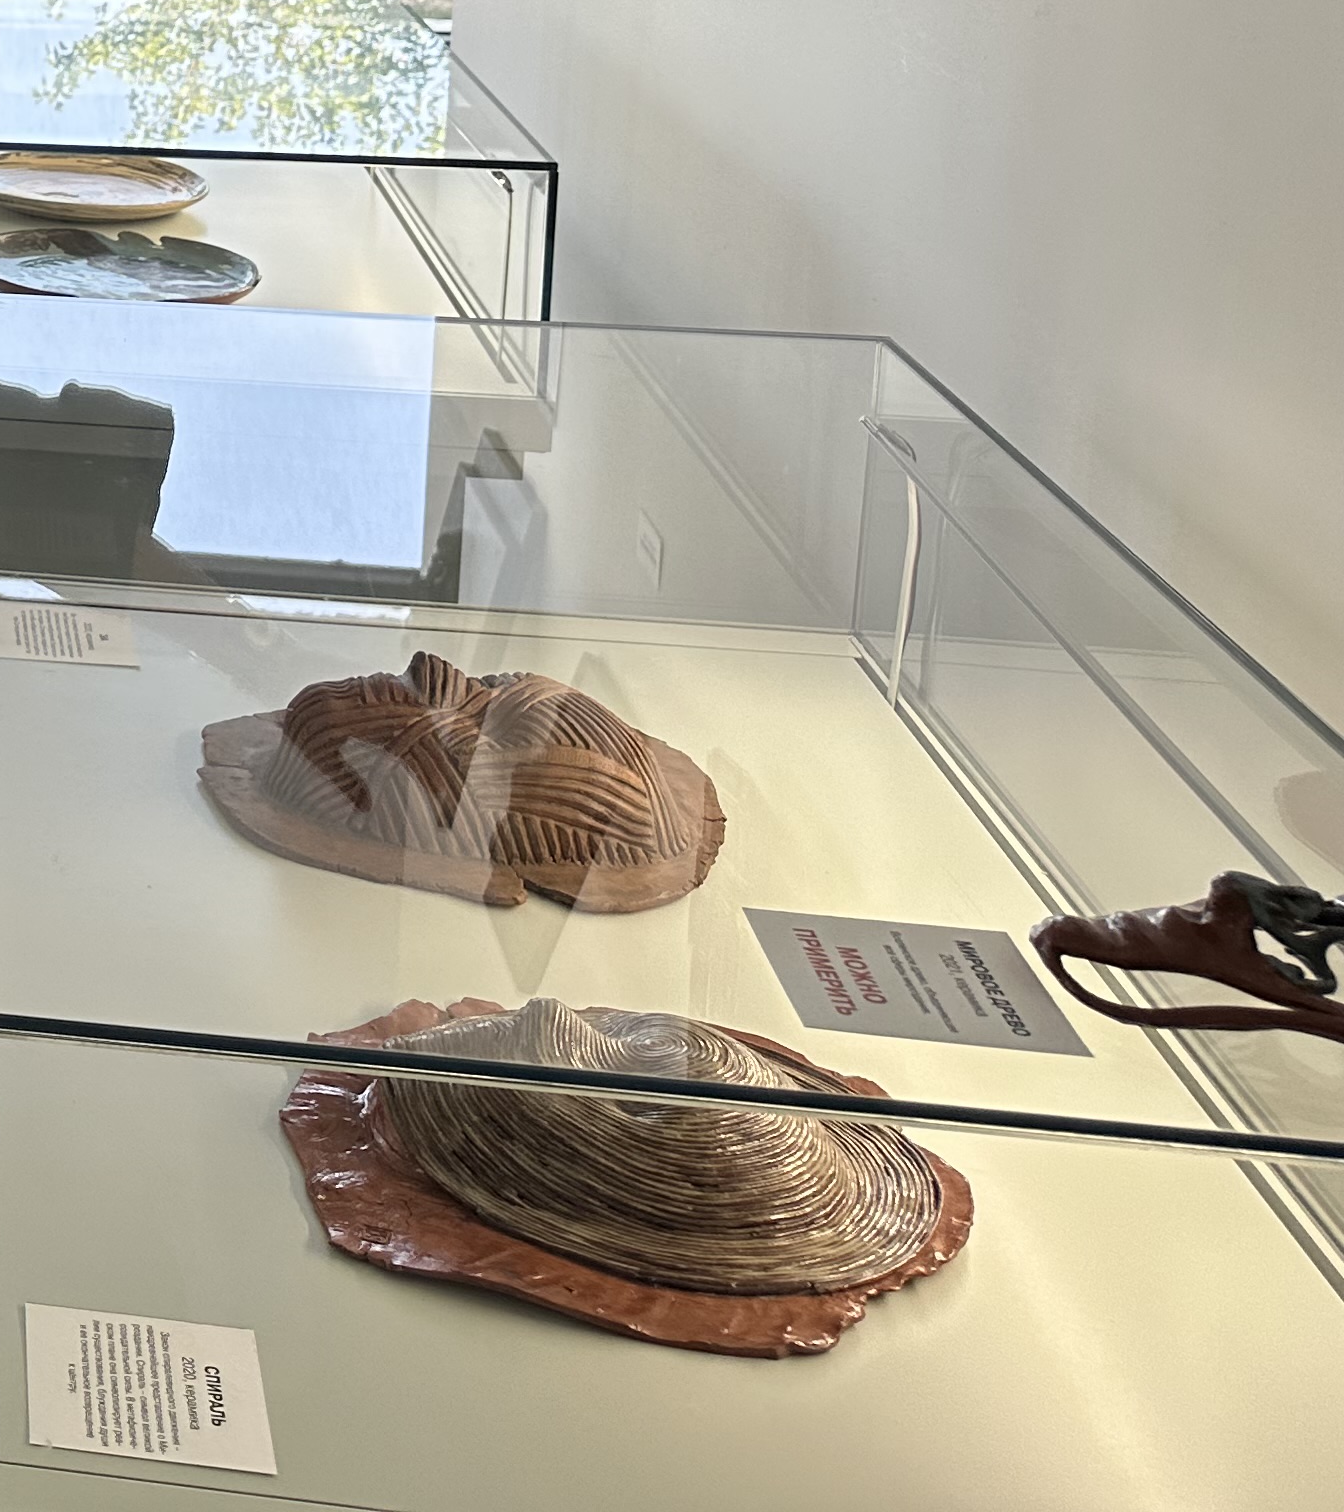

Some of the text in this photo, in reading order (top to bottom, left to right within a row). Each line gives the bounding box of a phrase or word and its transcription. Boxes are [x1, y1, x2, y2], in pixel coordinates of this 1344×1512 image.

[792, 928, 858, 1016] ПРИМЕРИТЬ
[835, 946, 888, 1004] МОЖНО
[954, 940, 1031, 1037] МИРОВОЕ ДРЕВО
[181, 1356, 200, 1430] 2020, керамика
[204, 1366, 226, 1426] СПИРАЛЬ
